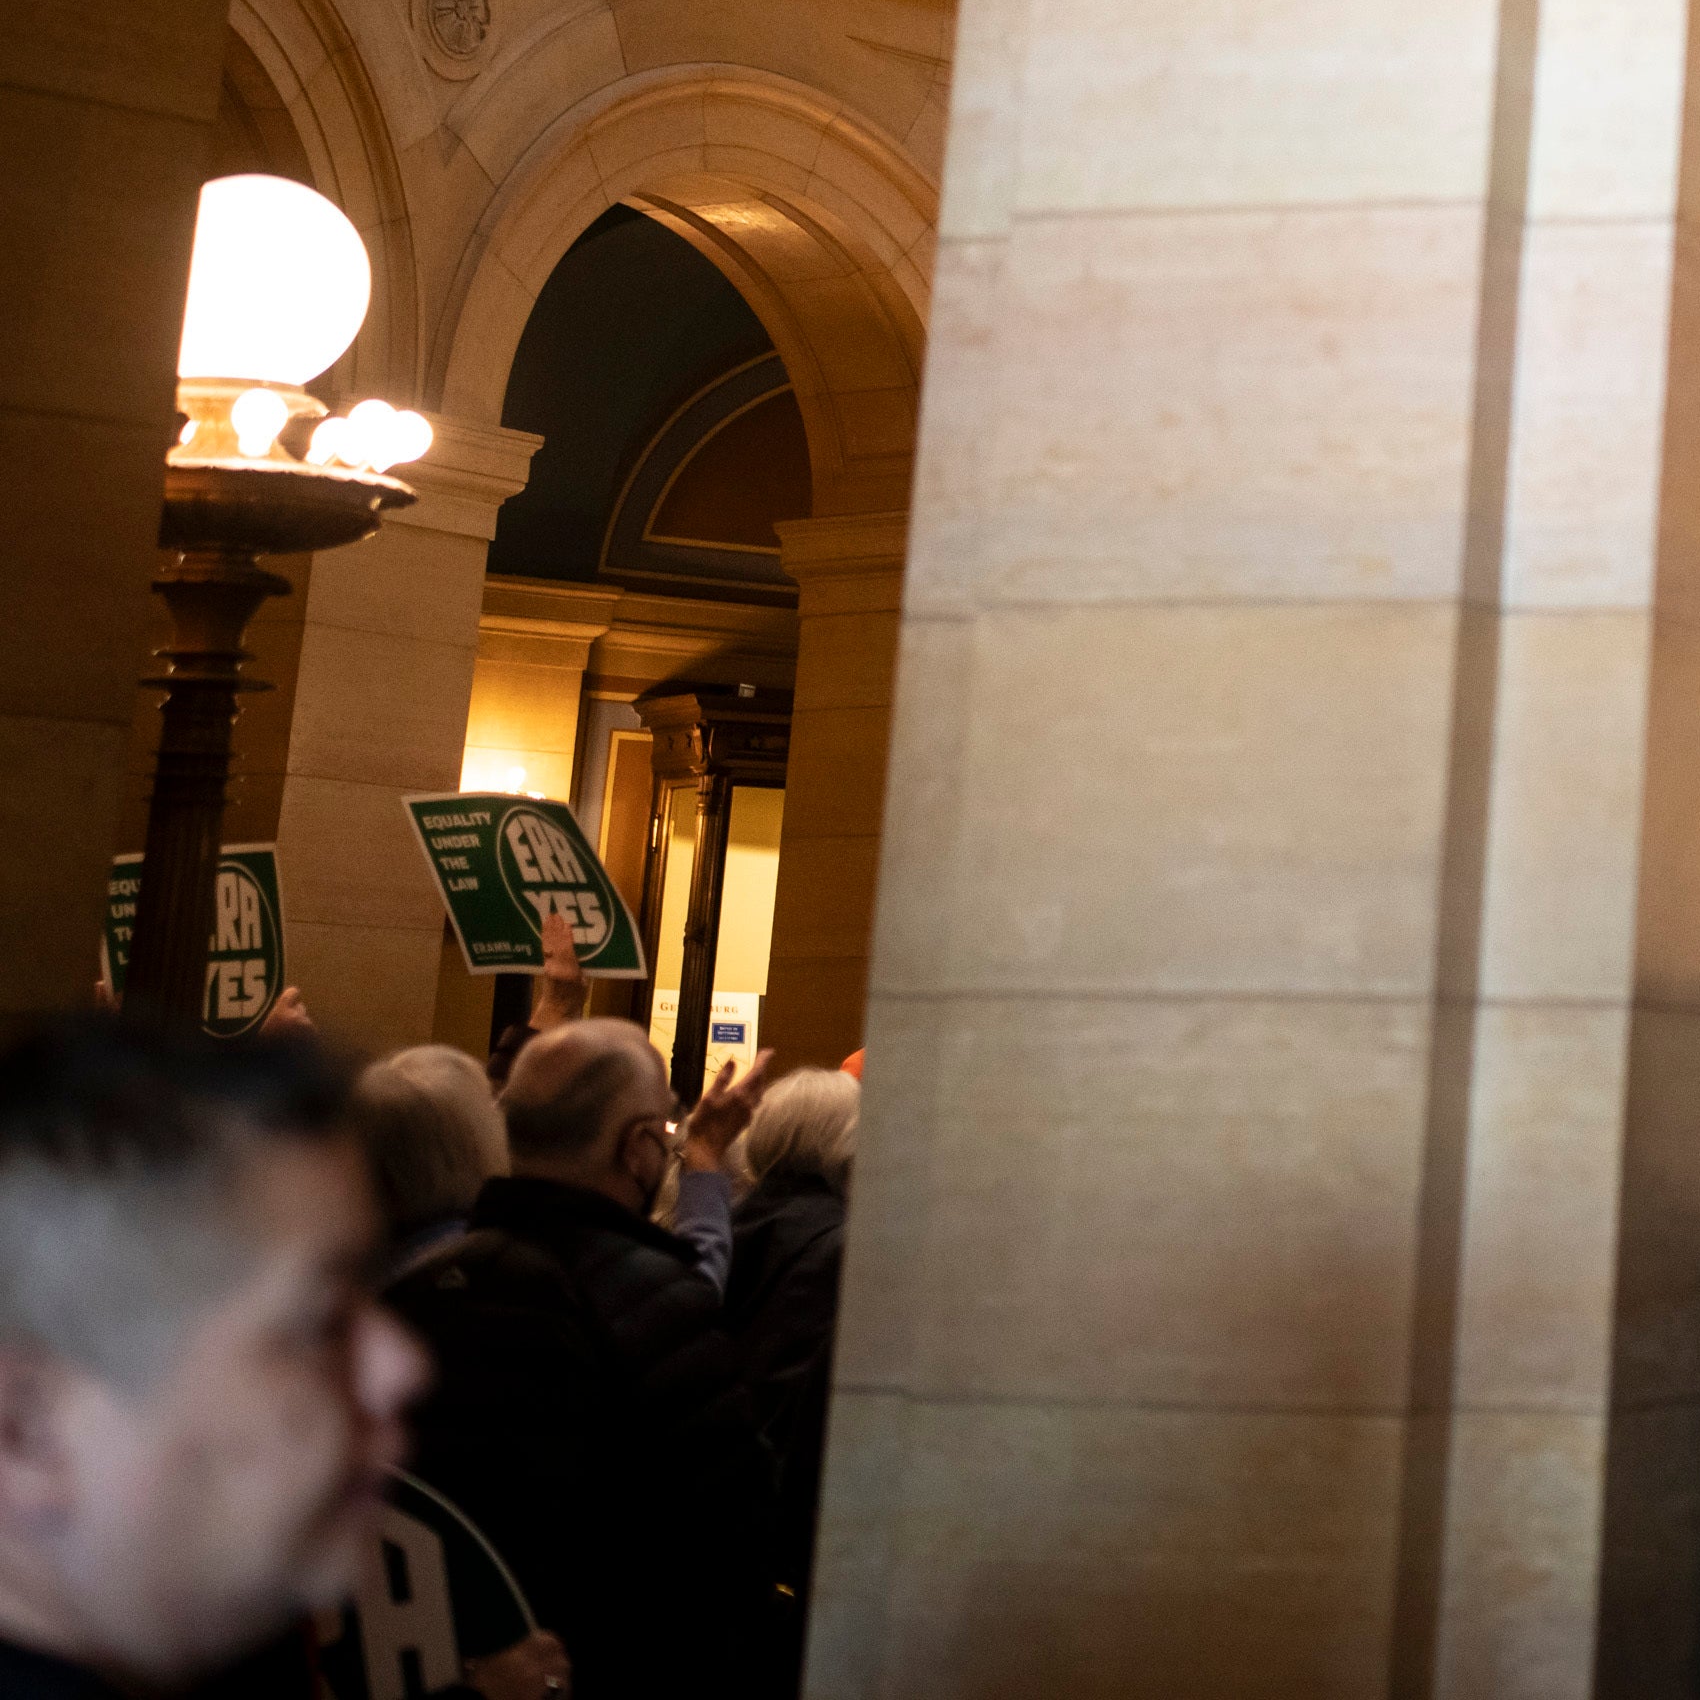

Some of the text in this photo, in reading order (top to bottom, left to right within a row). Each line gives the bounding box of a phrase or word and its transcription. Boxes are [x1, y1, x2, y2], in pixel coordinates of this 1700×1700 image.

[422, 811, 492, 831] EQUALITY
[430, 833, 481, 850] UNDER
[505, 813, 588, 884] ERA
[439, 856, 470, 870] THE
[447, 876, 479, 892] LAW
[208, 872, 262, 951] RA
